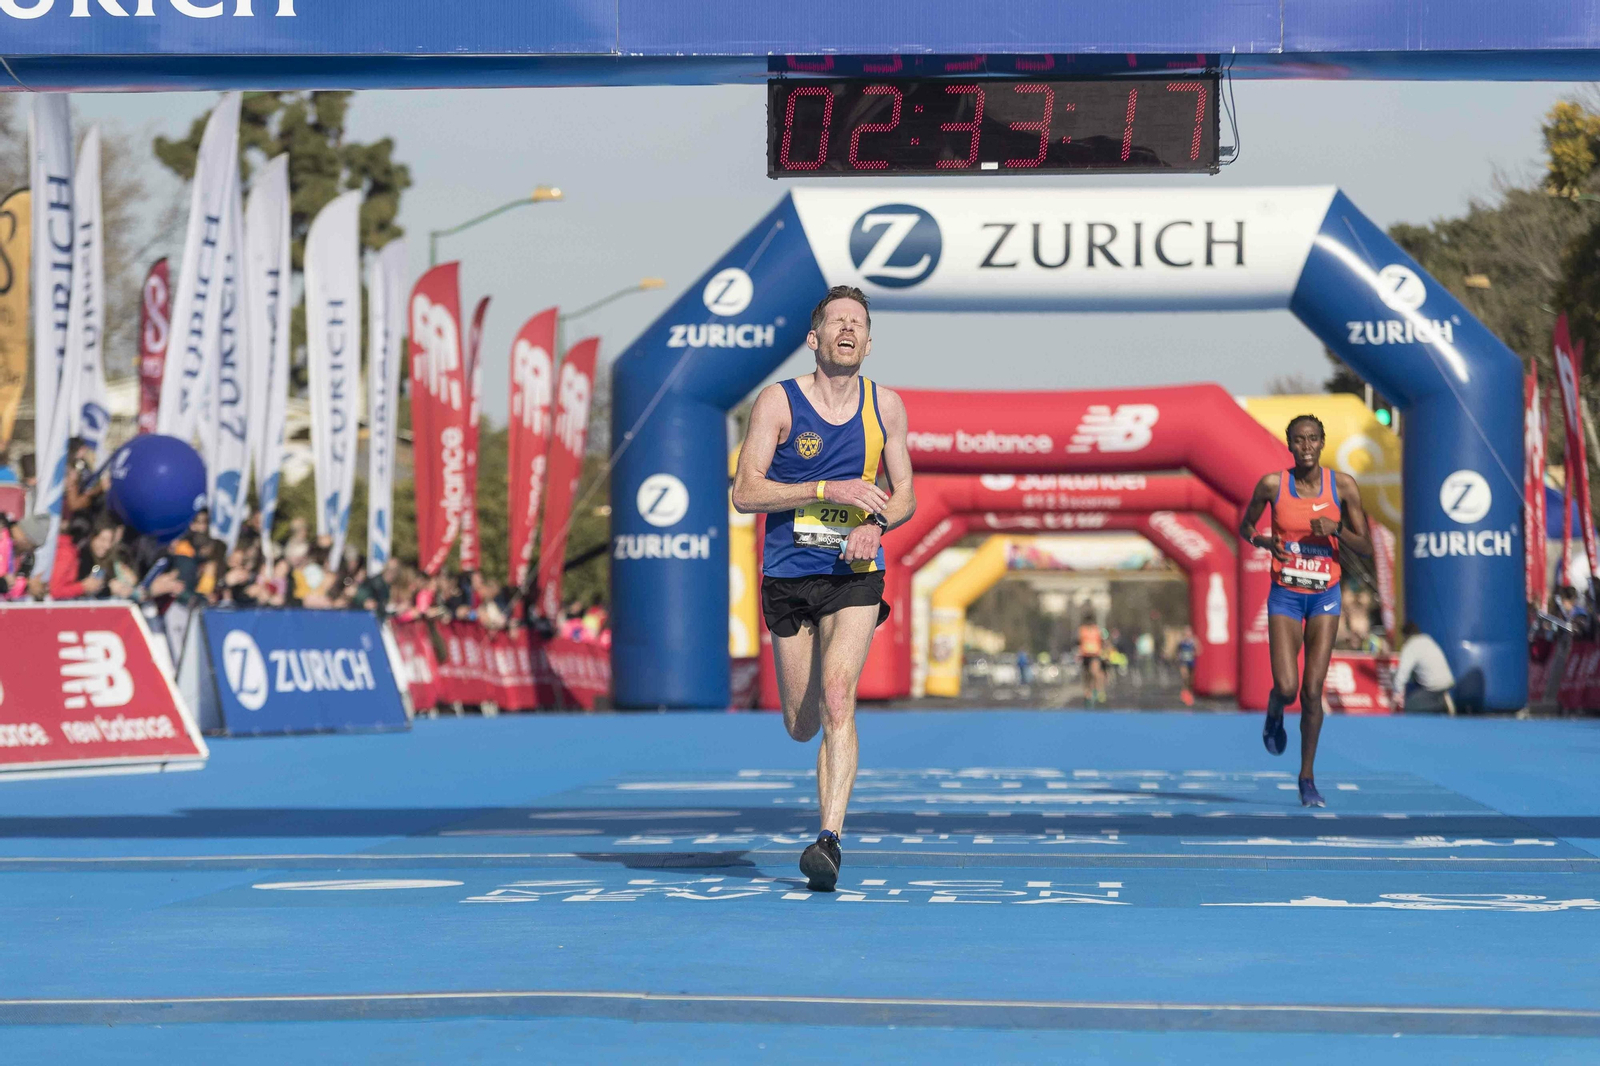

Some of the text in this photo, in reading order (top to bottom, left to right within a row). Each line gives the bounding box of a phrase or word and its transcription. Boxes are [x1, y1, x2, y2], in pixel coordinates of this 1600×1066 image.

[780, 82, 1207, 170] 02:33:17
[979, 220, 1246, 269] ZURICH
[667, 324, 775, 349] ZURICH
[1346, 320, 1454, 345] ZURICH
[907, 432, 954, 452] new
[956, 429, 1053, 453] balance
[820, 508, 849, 524] 279
[613, 534, 710, 560] ZURICH
[1413, 530, 1512, 559] ZURICH
[269, 649, 376, 693] ZURICH
[61, 720, 101, 744] new
[95, 713, 177, 742] balance
[458, 892, 1133, 906] SEVILLA
